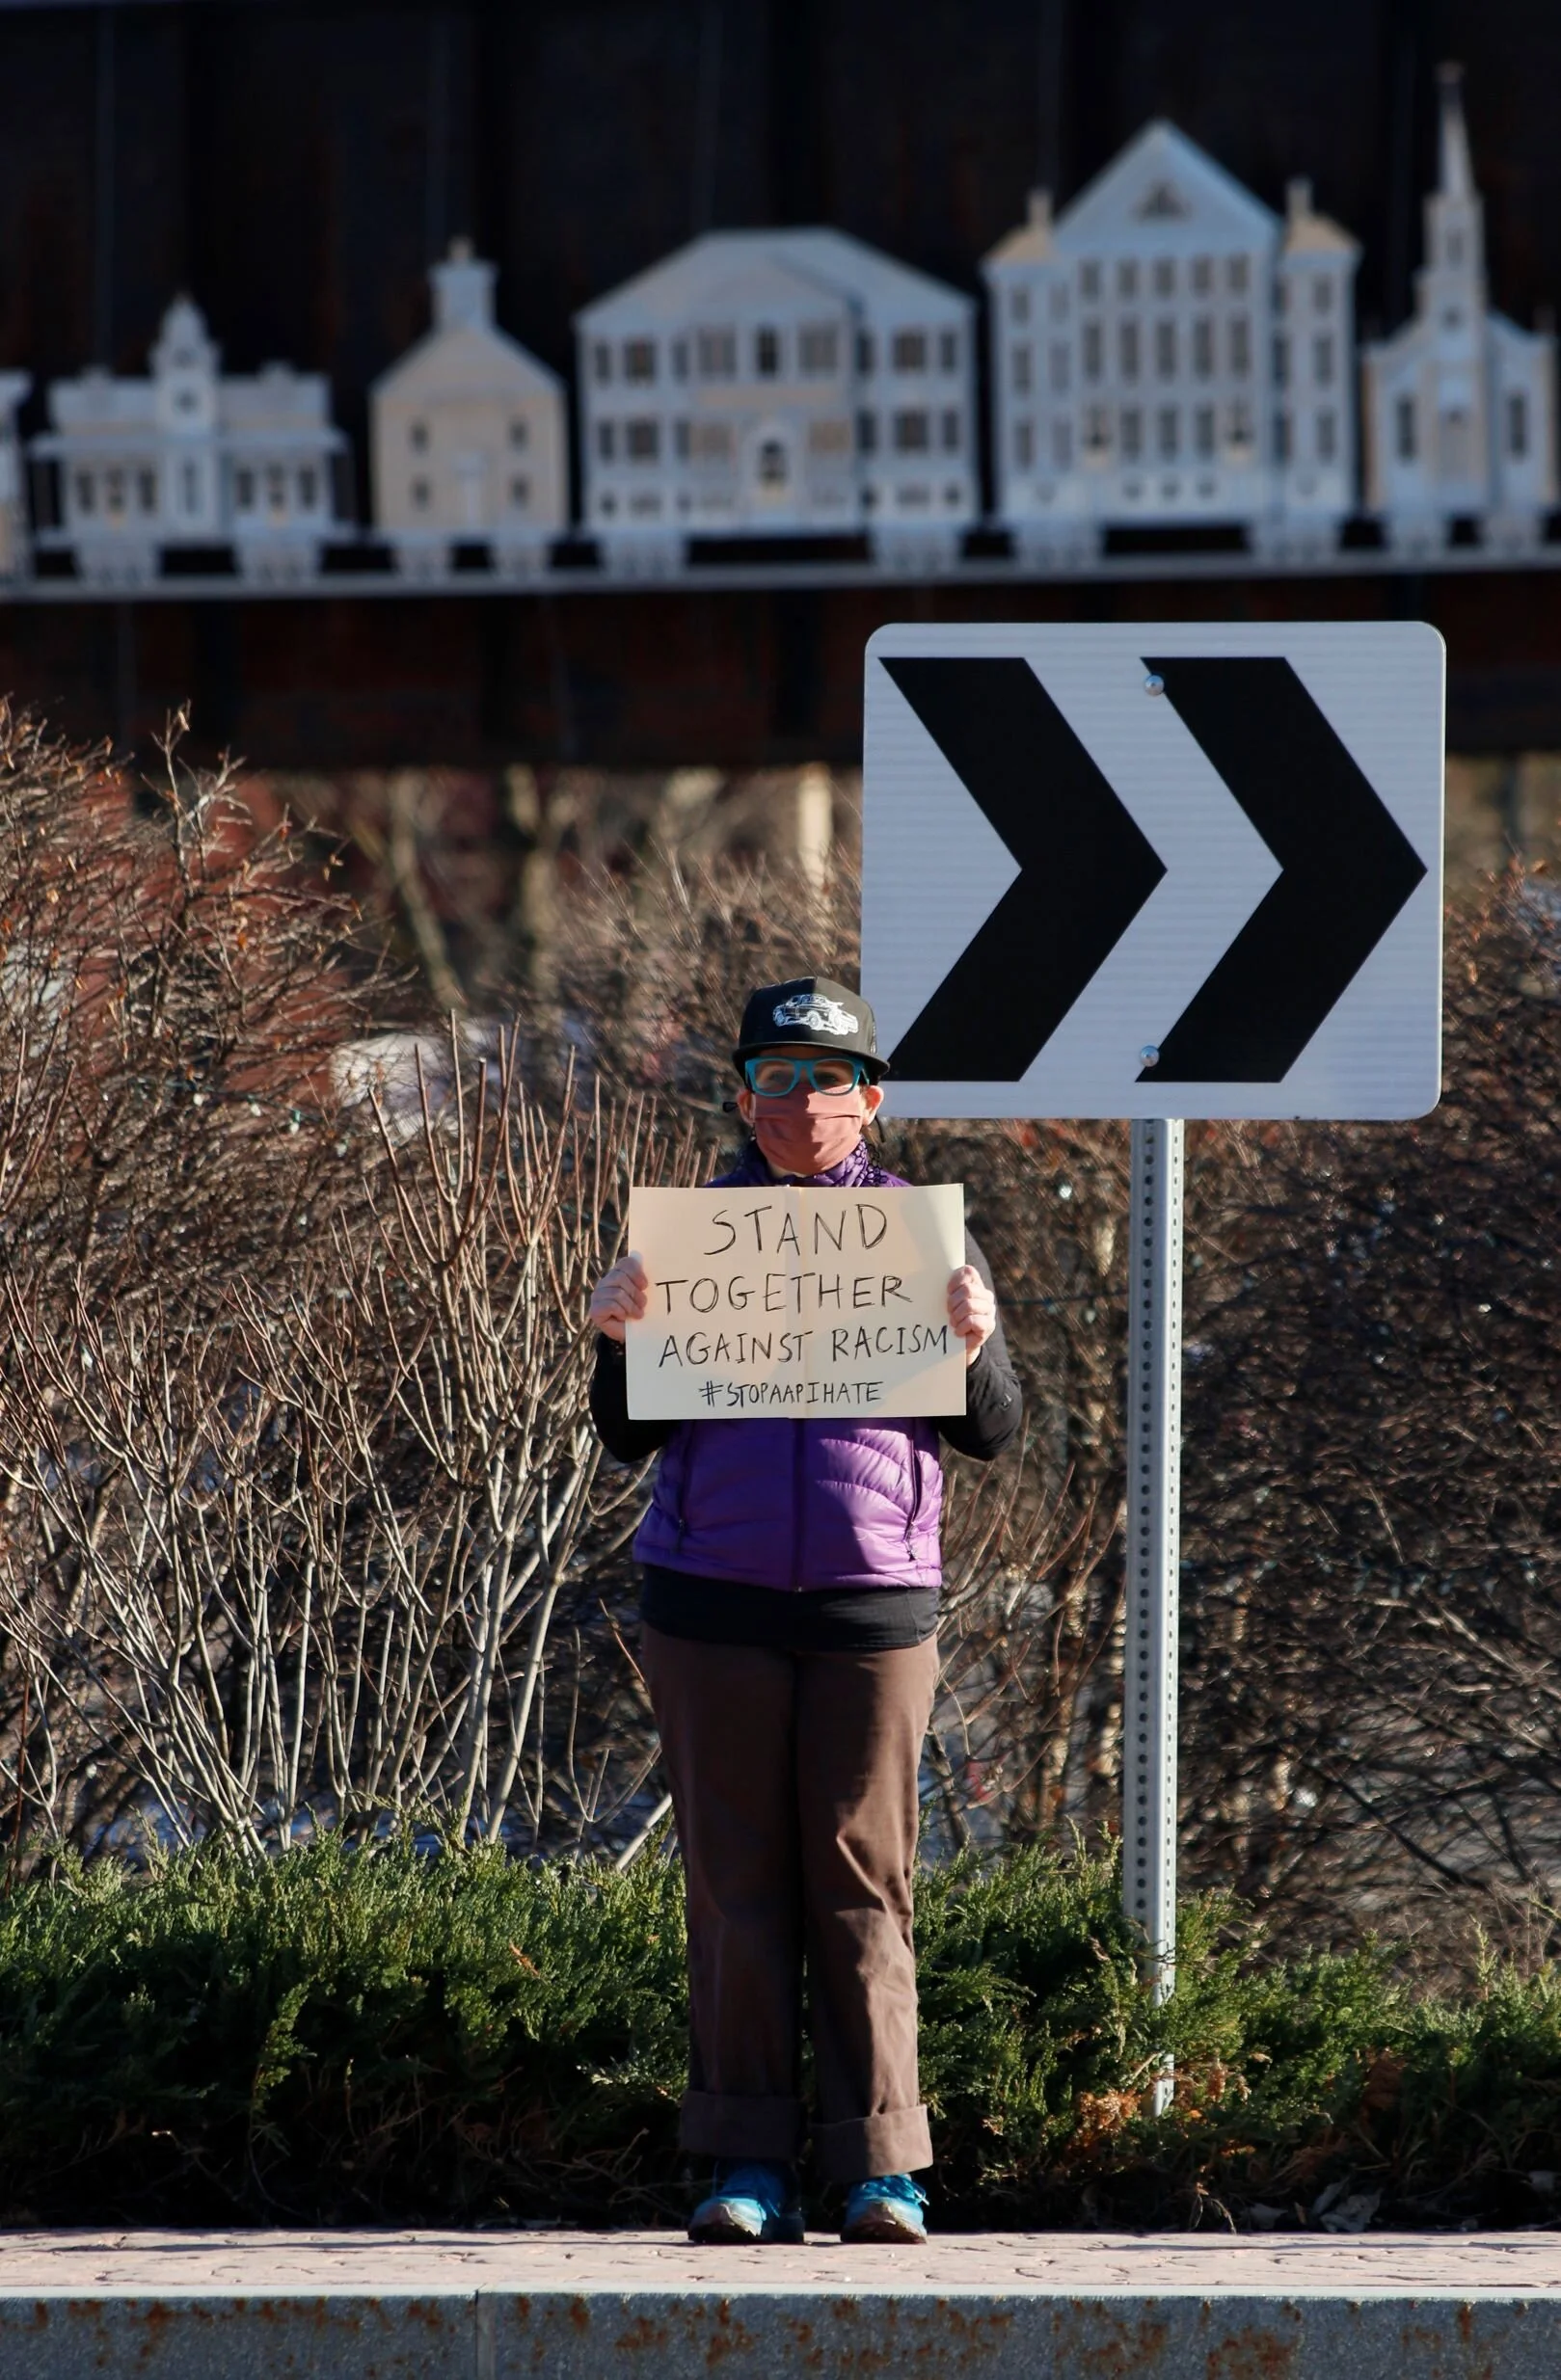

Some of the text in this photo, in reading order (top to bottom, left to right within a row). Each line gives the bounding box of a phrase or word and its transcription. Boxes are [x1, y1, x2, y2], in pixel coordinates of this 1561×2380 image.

[704, 1204, 887, 1256] STAND
[657, 1272, 912, 1314] TOGETHER
[659, 1324, 948, 1367] AGAINST RACISM
[699, 1380, 883, 1407] #STOPAAPIHATE
